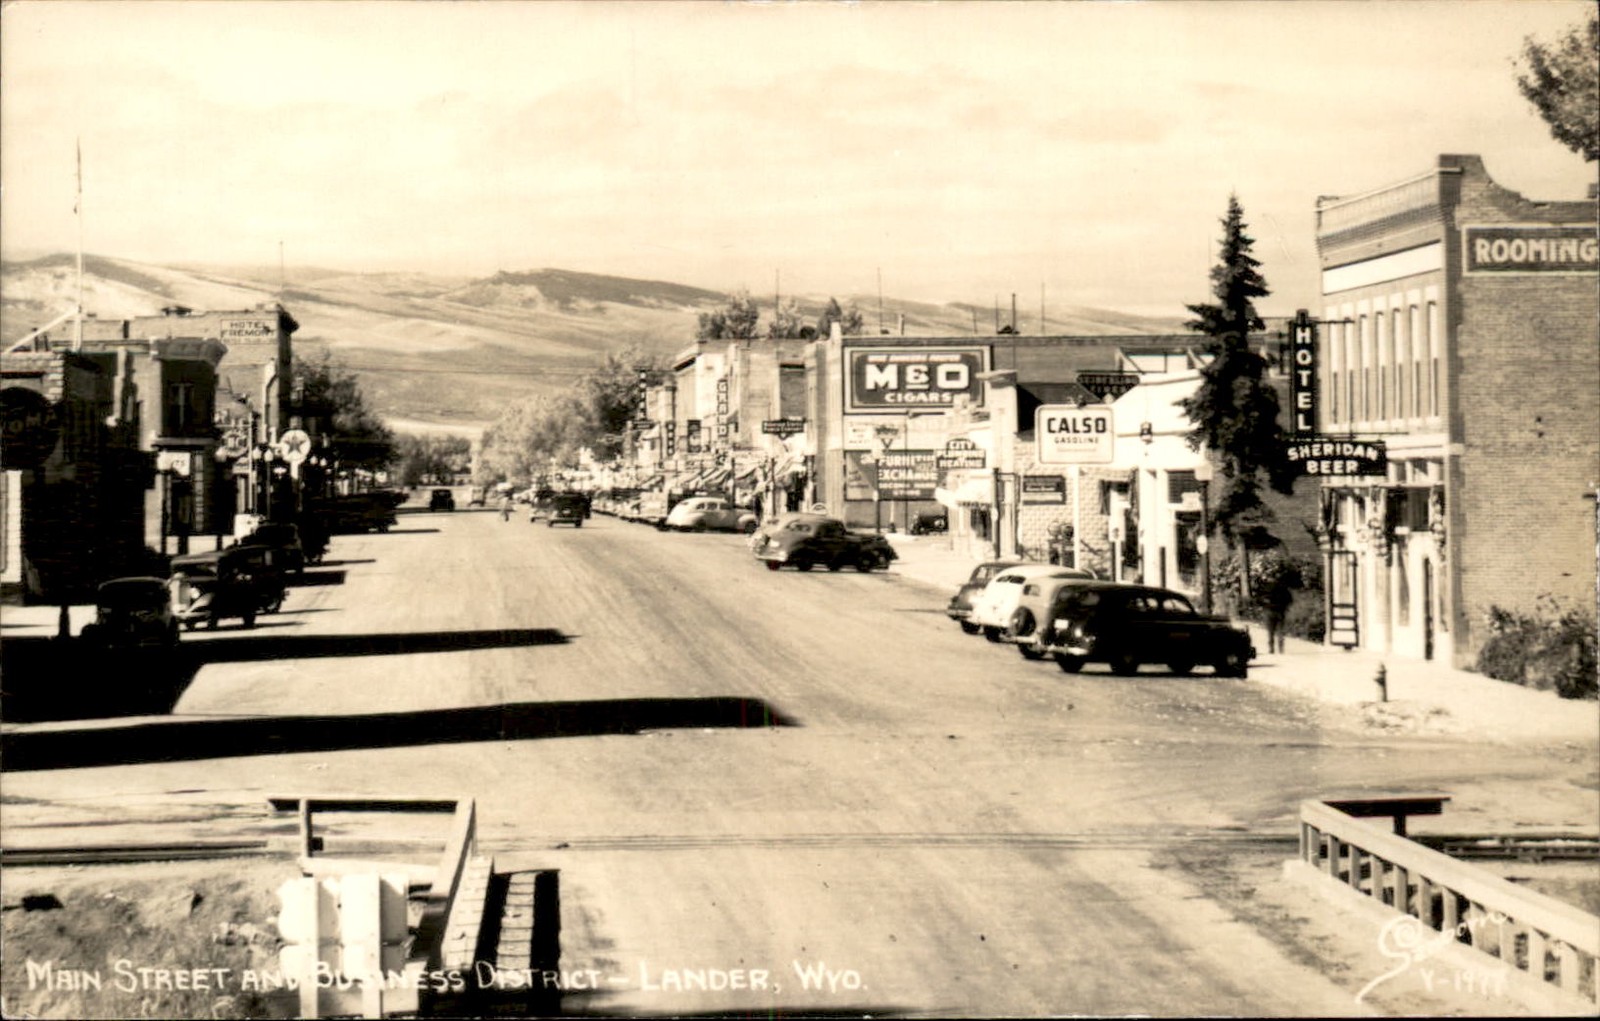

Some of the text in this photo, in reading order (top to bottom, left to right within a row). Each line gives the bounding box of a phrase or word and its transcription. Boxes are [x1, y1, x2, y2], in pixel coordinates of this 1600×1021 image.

[1474, 237, 1598, 263] ROOMING
[1295, 326, 1313, 430] HOTEL
[884, 391, 952, 403] CIGARS
[1046, 416, 1107, 434] CALSO
[949, 440, 974, 450] CITY
[1054, 436, 1100, 444] GASOLINE
[1286, 442, 1379, 461] SHERIDAN
[1305, 460, 1359, 474] BEER
